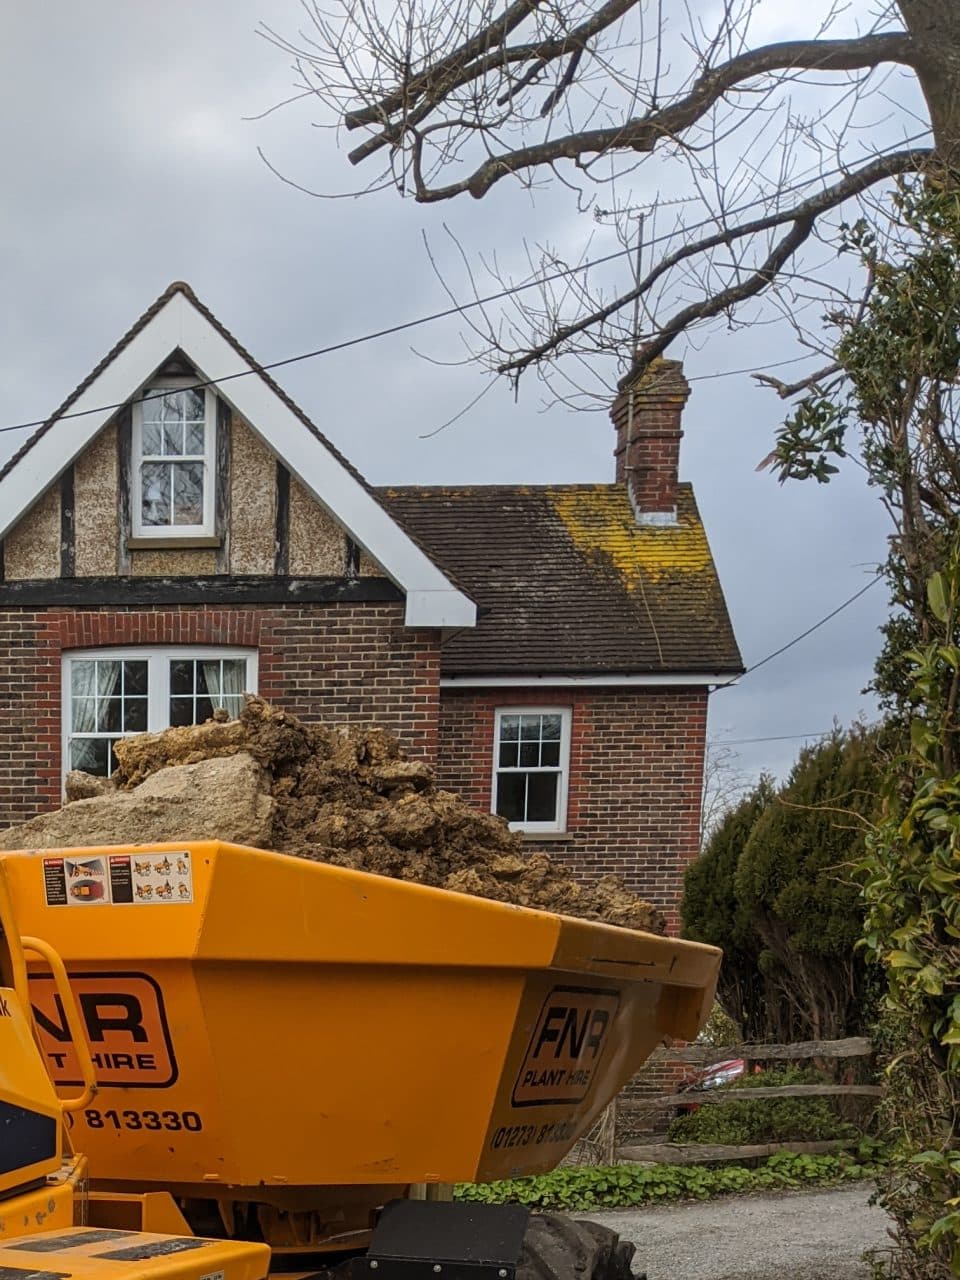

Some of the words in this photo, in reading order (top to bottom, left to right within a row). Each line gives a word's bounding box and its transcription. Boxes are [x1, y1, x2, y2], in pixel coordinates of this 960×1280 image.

[30, 993, 149, 1042] NR
[532, 1006, 610, 1060] FNR
[522, 1070, 567, 1088] PLANT
[84, 1109, 203, 1132] 813330
